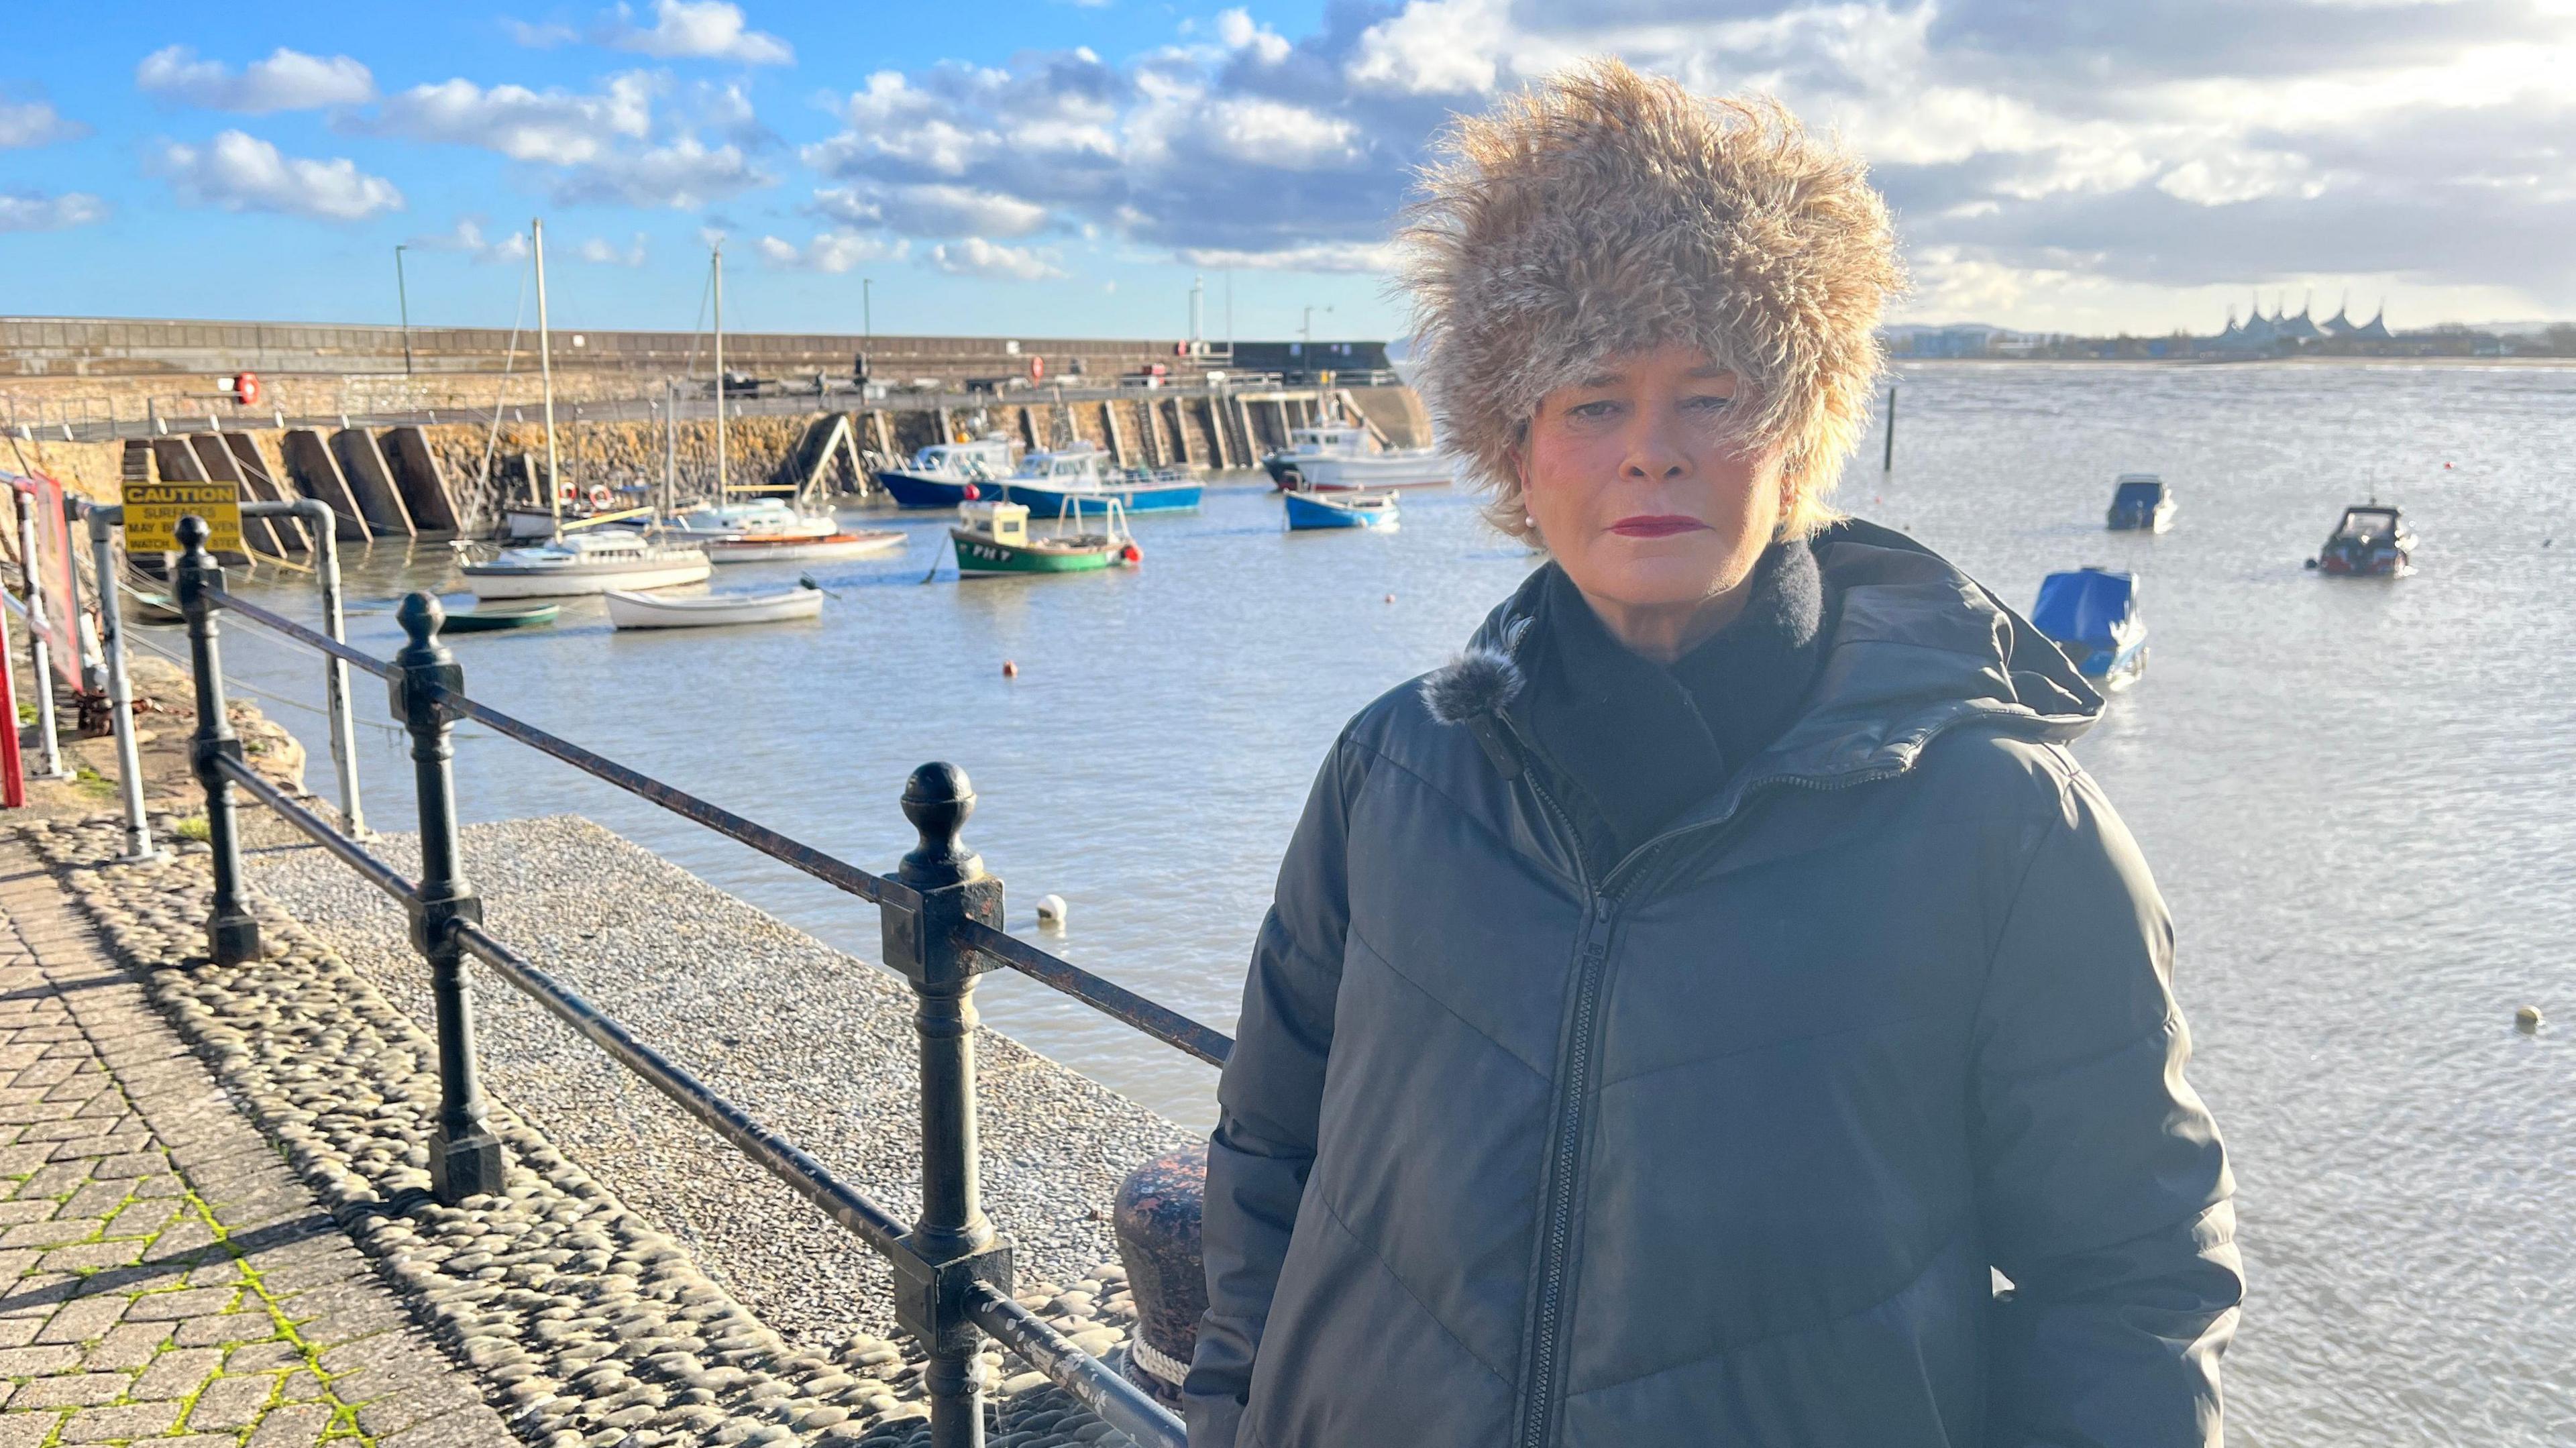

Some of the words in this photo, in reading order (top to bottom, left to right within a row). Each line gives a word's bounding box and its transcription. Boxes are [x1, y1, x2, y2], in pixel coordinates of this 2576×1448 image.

[127, 488, 234, 503] CAUTION
[144, 507, 216, 518] SURFACES
[129, 523, 155, 533] MAY
[130, 540, 170, 548] WATCH
[212, 539, 239, 547] STEP
